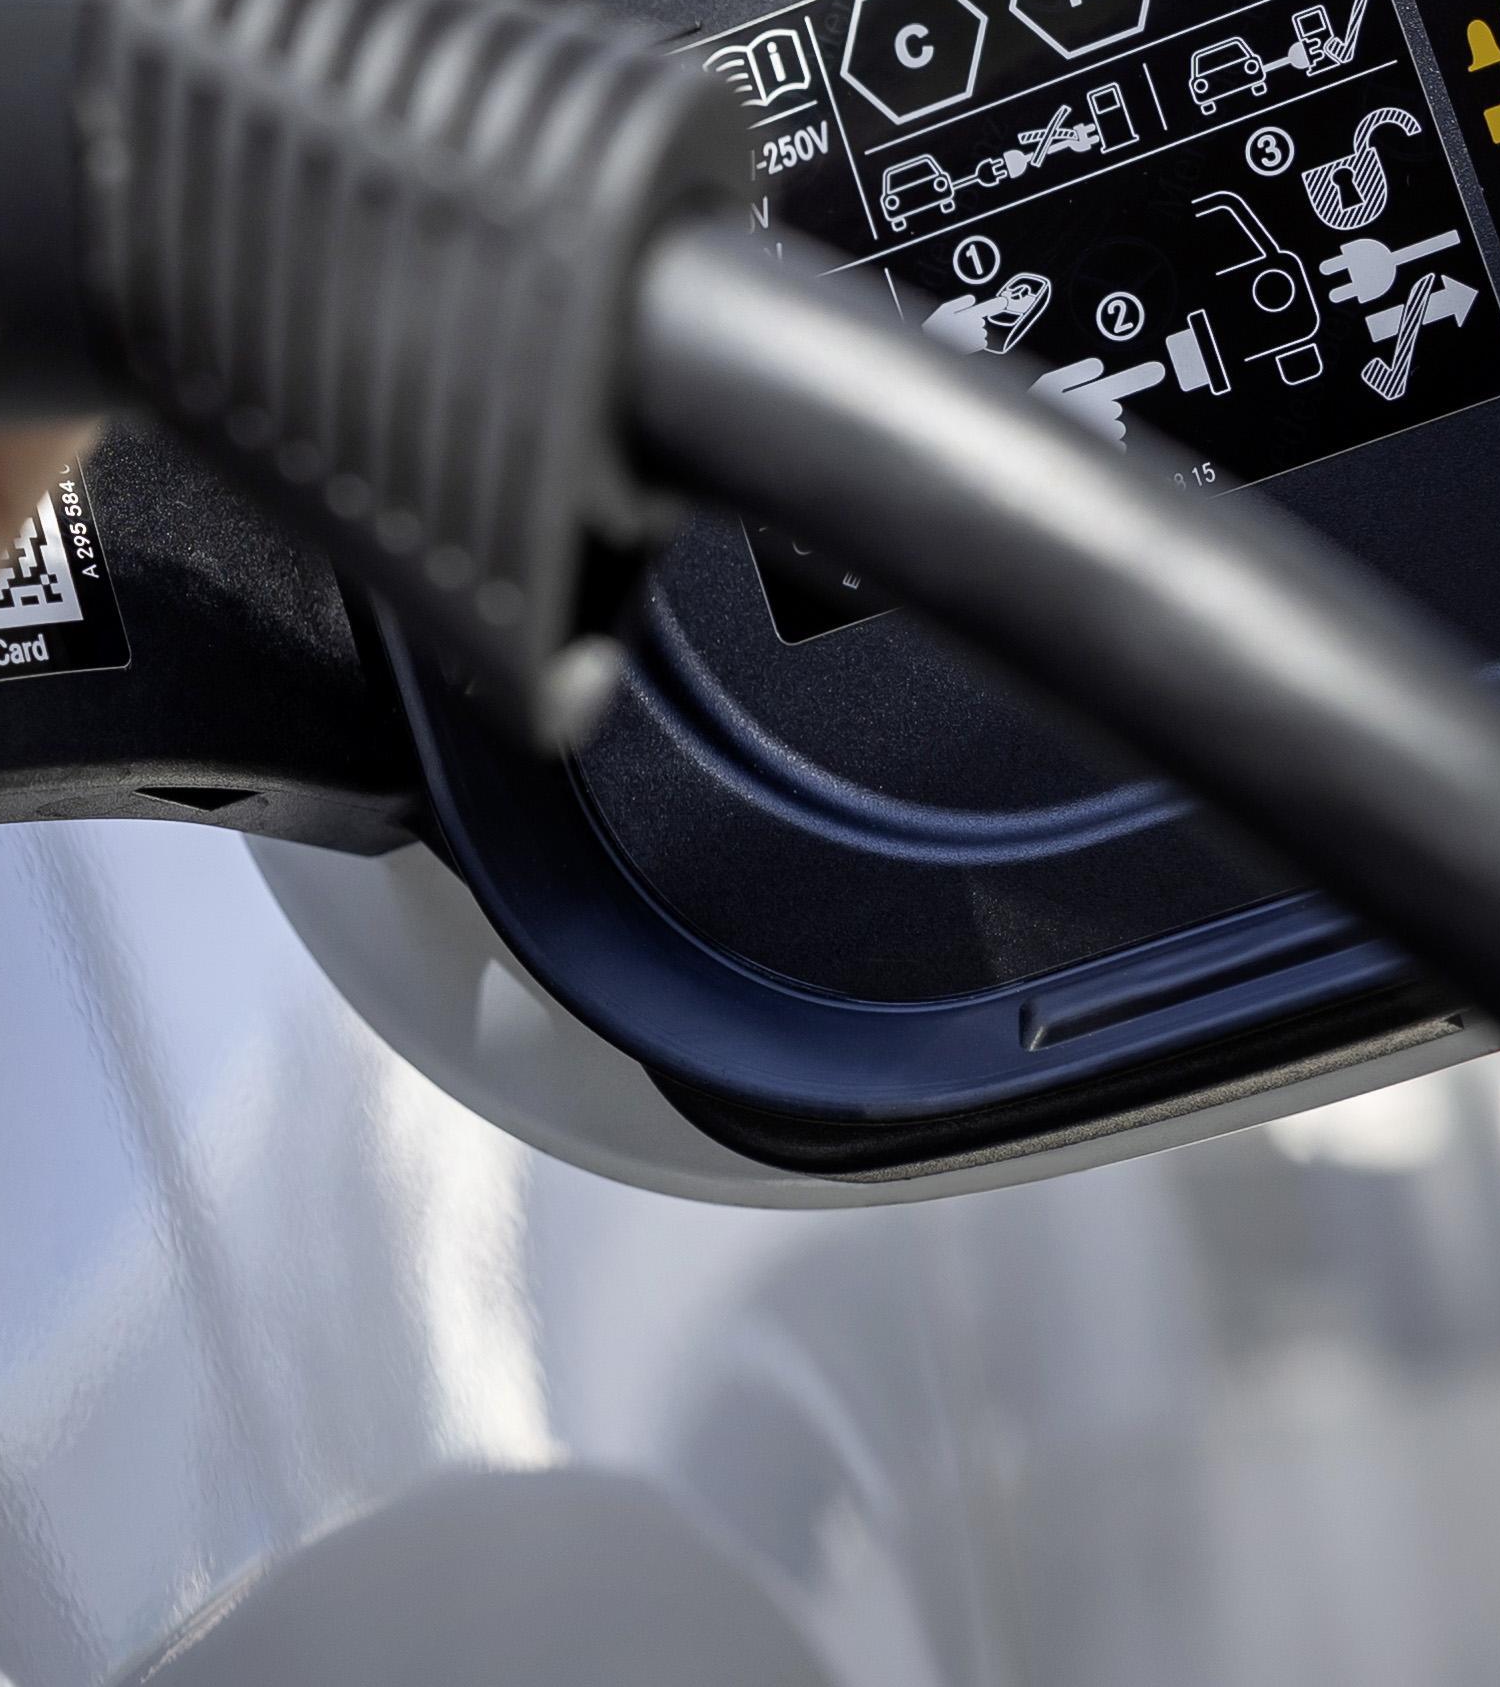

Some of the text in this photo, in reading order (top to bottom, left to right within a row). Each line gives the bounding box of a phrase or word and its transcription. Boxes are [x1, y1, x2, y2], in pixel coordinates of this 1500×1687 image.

[894, 23, 934, 69] C
[1191, 461, 1216, 487] 15
[58, 480, 82, 517] 584
[69, 522, 94, 559] 295
[82, 564, 99, 579] A
